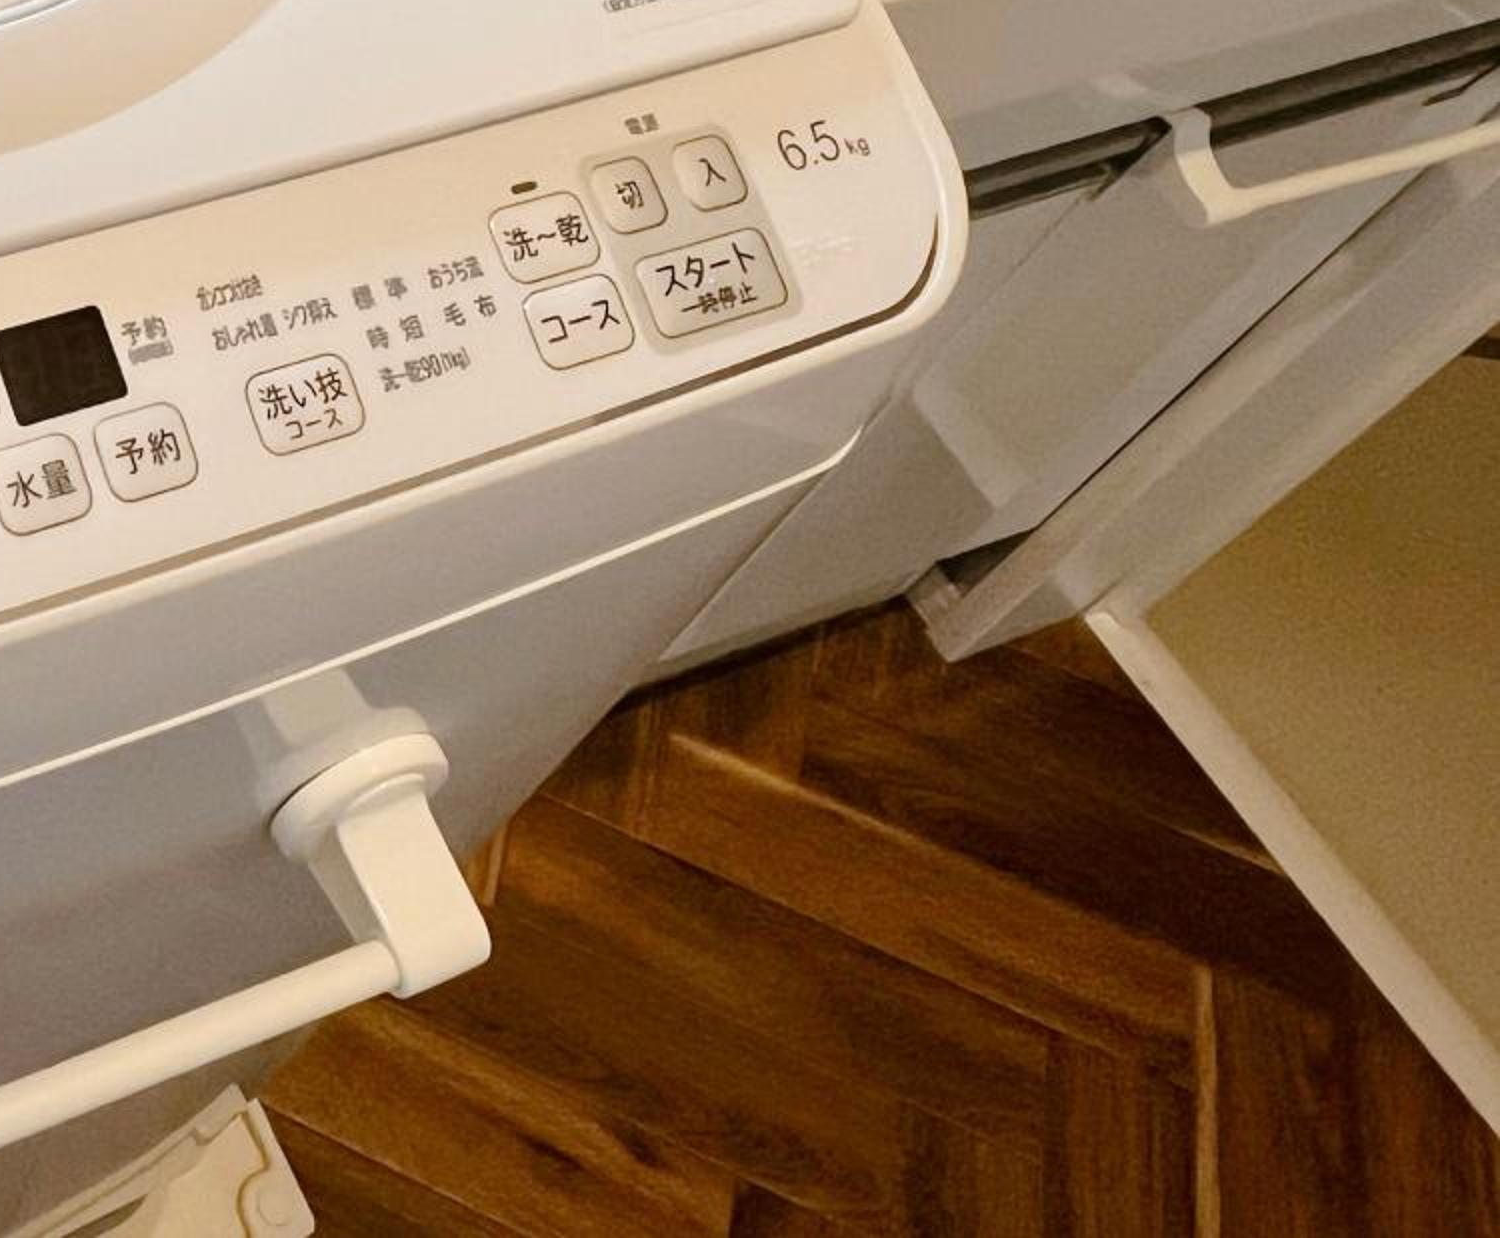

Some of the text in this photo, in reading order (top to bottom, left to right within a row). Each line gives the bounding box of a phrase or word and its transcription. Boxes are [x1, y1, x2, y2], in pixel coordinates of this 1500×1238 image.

[704, 159, 727, 186] 入
[616, 184, 644, 209] 切
[657, 243, 755, 295] スタート
[681, 284, 758, 314] 一時停止
[122, 317, 166, 345] 予約
[542, 301, 620, 343] コース
[260, 368, 348, 419] 洗い技
[286, 409, 342, 439] コース
[116, 429, 181, 475] 予約
[7, 459, 75, 509] 水量
